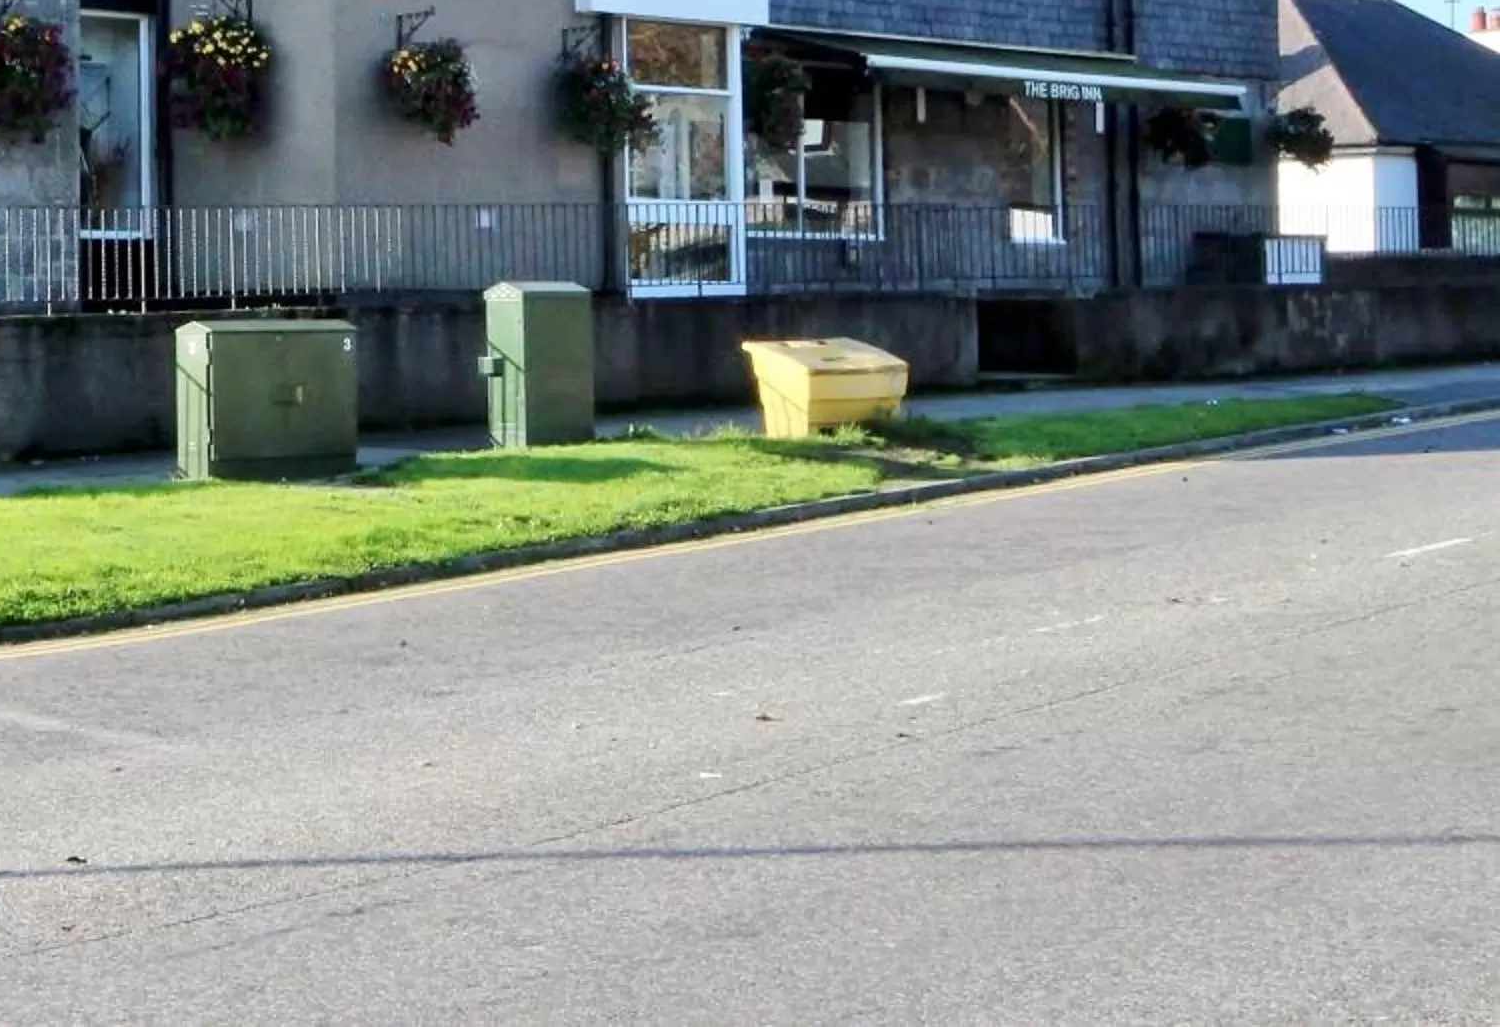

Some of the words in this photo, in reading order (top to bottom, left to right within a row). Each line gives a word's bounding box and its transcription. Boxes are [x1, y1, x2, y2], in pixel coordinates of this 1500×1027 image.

[1024, 80, 1049, 99] THE
[1050, 82, 1080, 101] BRIG
[1081, 85, 1103, 102] INN
[343, 337, 351, 352] 3
